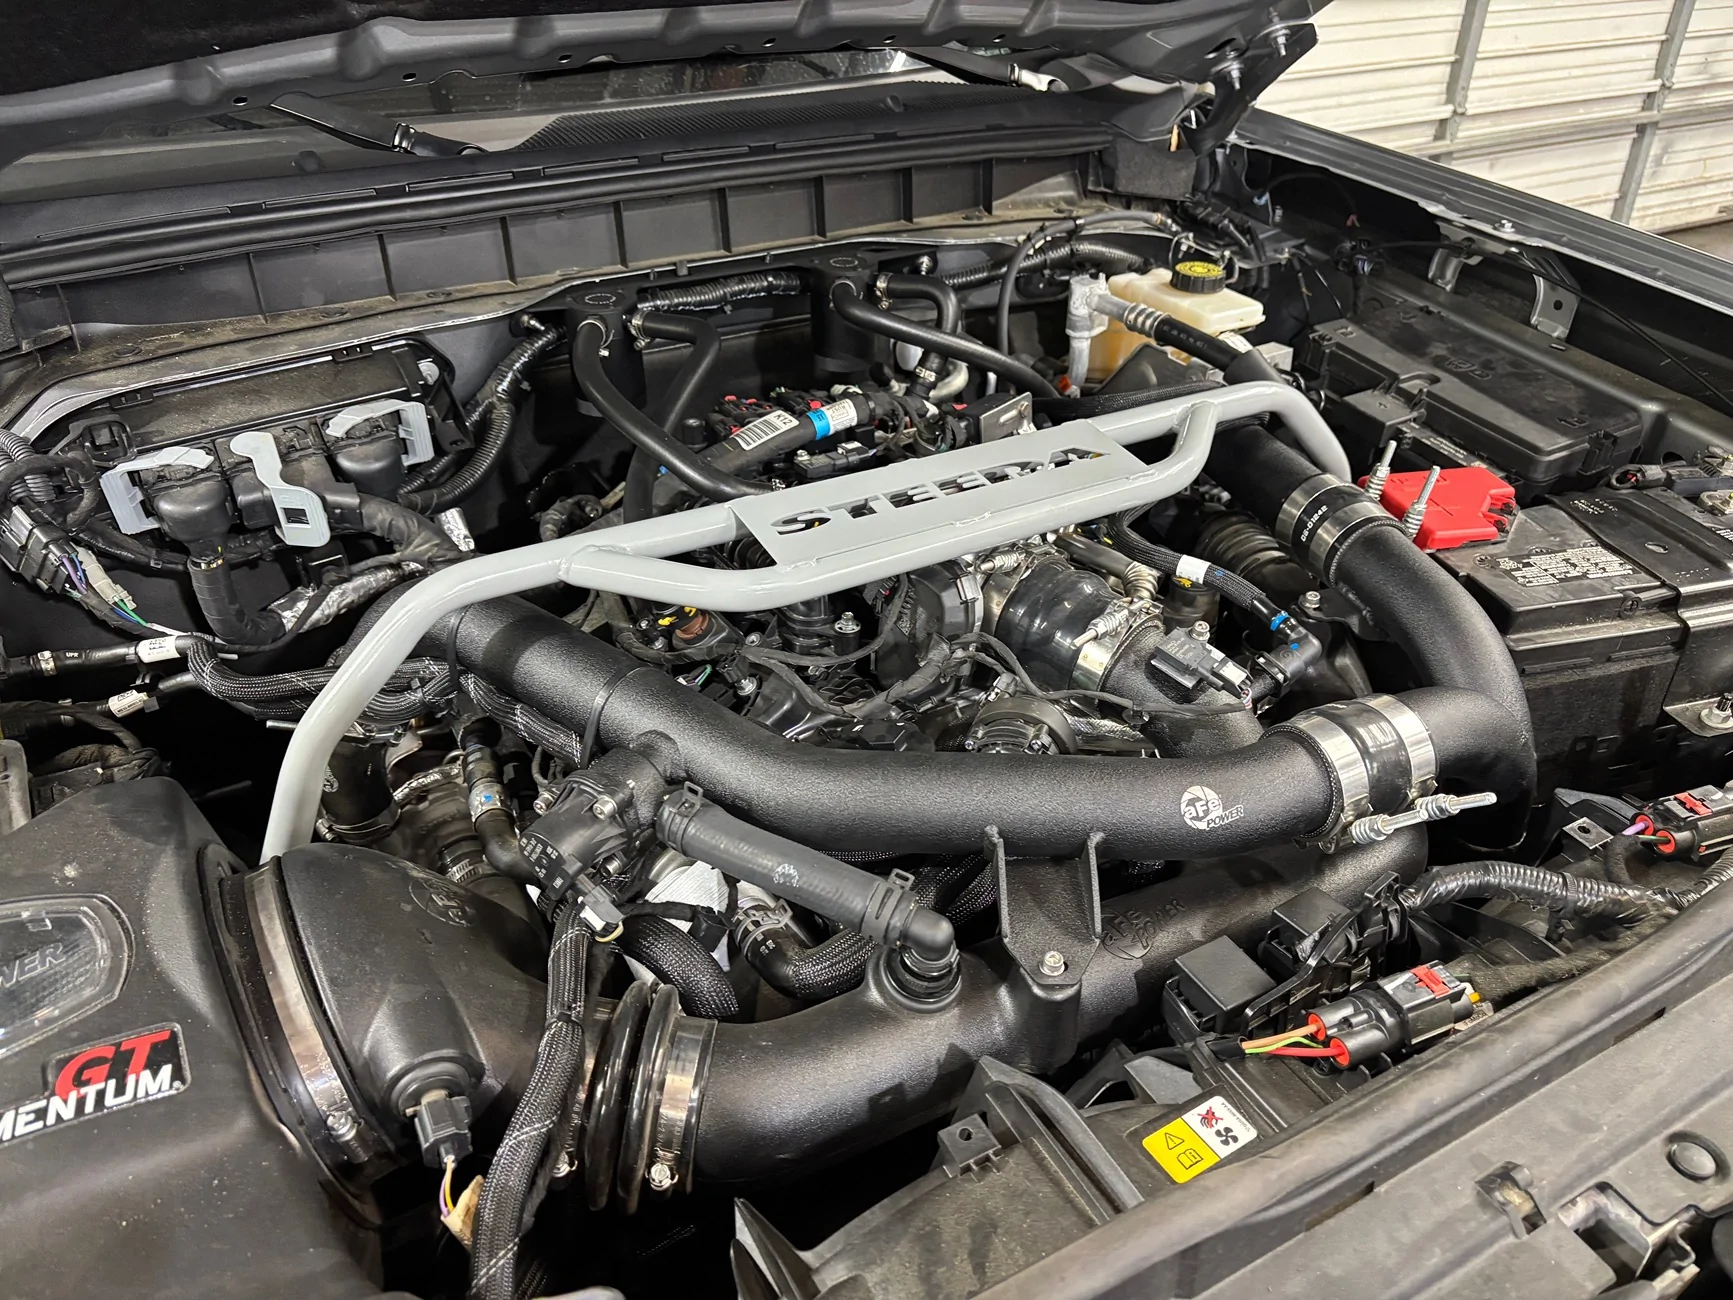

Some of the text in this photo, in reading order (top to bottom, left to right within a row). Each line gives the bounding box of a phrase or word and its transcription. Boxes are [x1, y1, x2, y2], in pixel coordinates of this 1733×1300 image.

[773, 413, 794, 426] K12
[770, 447, 1111, 535] STEEDA
[1183, 798, 1221, 819] aFe
[1206, 805, 1243, 829] POWER
[54, 1029, 171, 1098] GT
